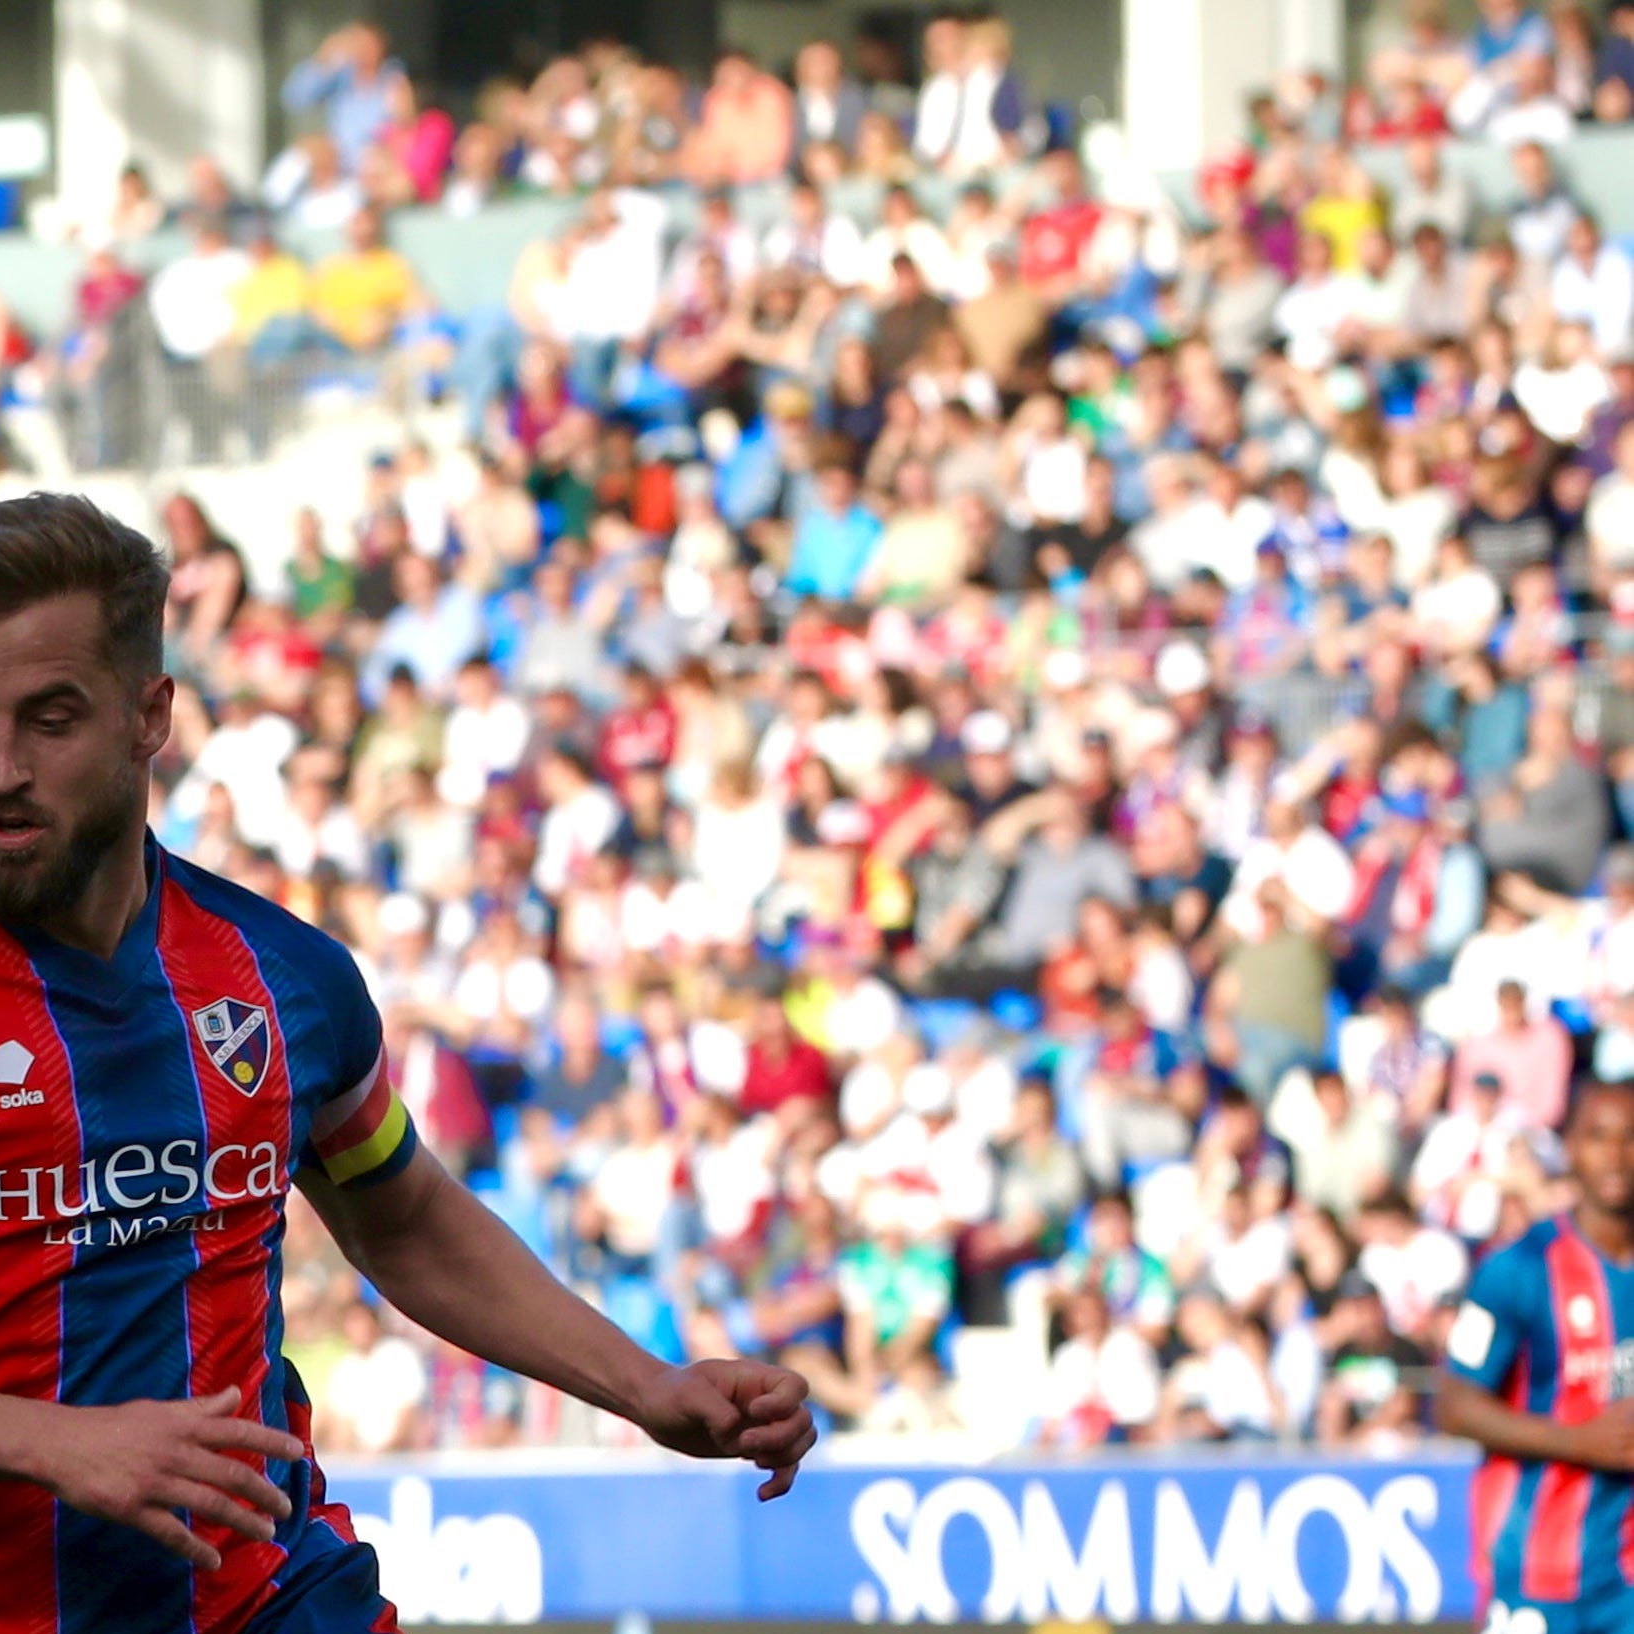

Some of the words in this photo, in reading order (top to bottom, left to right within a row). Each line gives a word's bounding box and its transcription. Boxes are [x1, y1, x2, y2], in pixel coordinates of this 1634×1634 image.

[0, 1088, 45, 1109] soka
[43, 1213, 95, 1246] La
[849, 1473, 1442, 1625] SOMMOS
